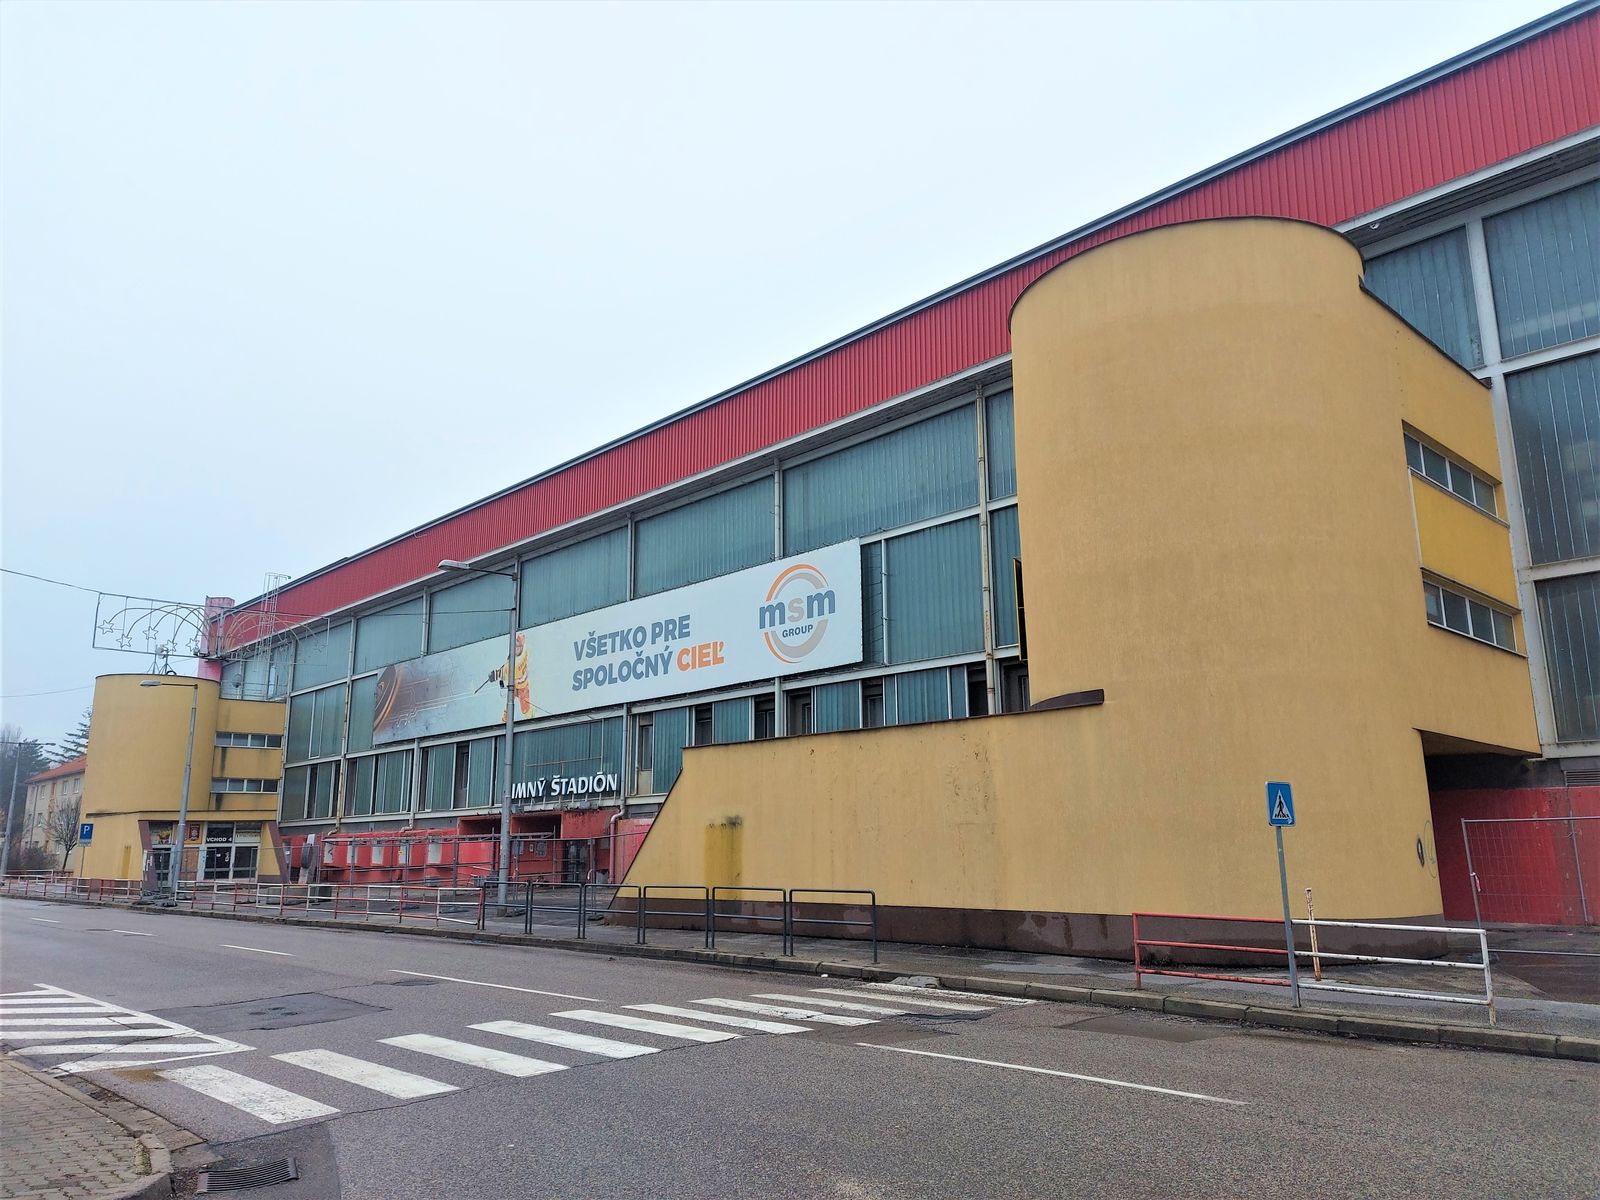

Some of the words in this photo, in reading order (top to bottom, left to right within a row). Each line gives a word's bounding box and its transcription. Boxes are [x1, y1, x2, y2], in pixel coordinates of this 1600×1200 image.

[759, 590, 836, 630] msm
[573, 625, 647, 661] VŠETKO
[651, 614, 691, 645] PRE
[782, 624, 813, 638] GROUP
[572, 645, 674, 692] SPOLOČNÝ
[677, 641, 725, 672] CIEĽ
[511, 777, 546, 799] IMNÝ
[550, 771, 618, 796] ŠTADIÓN
[83, 825, 90, 835] P
